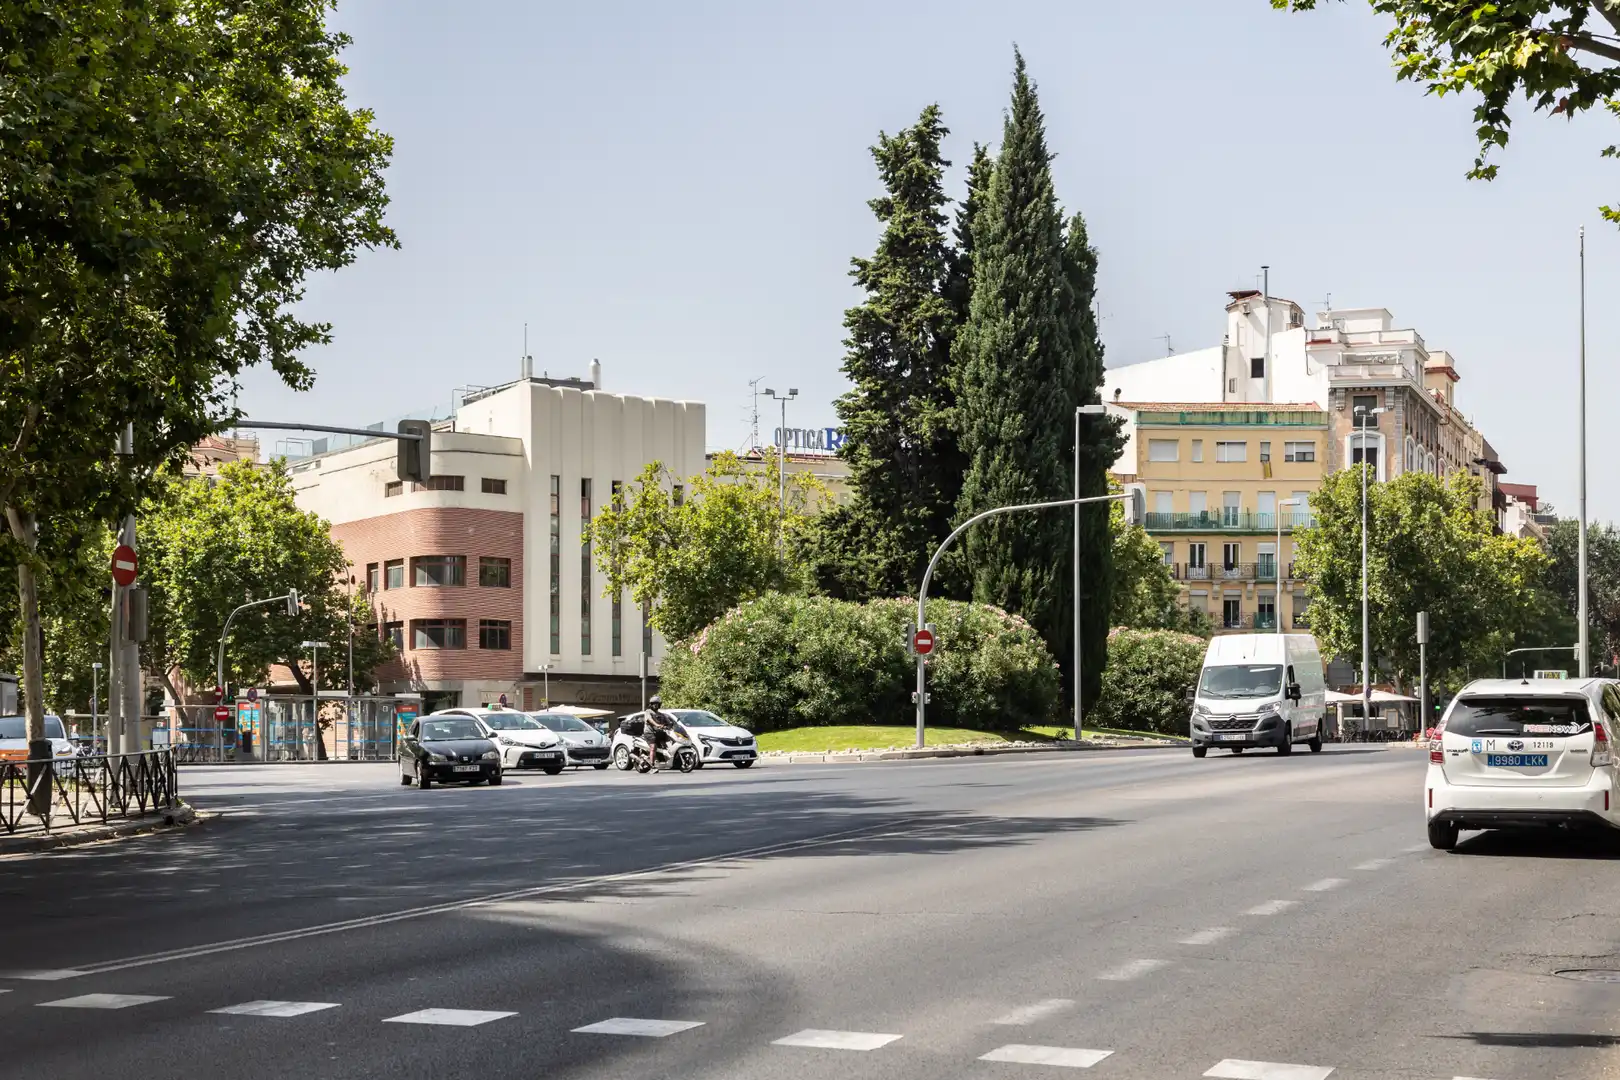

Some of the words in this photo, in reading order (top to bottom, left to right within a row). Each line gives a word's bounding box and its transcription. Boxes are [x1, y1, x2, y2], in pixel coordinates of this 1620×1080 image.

[774, 427, 825, 450] OPTICA
[824, 427, 848, 450] R
[1486, 739, 1496, 751] M
[1495, 755, 1521, 765] 9980
[1525, 755, 1545, 765] LKK
